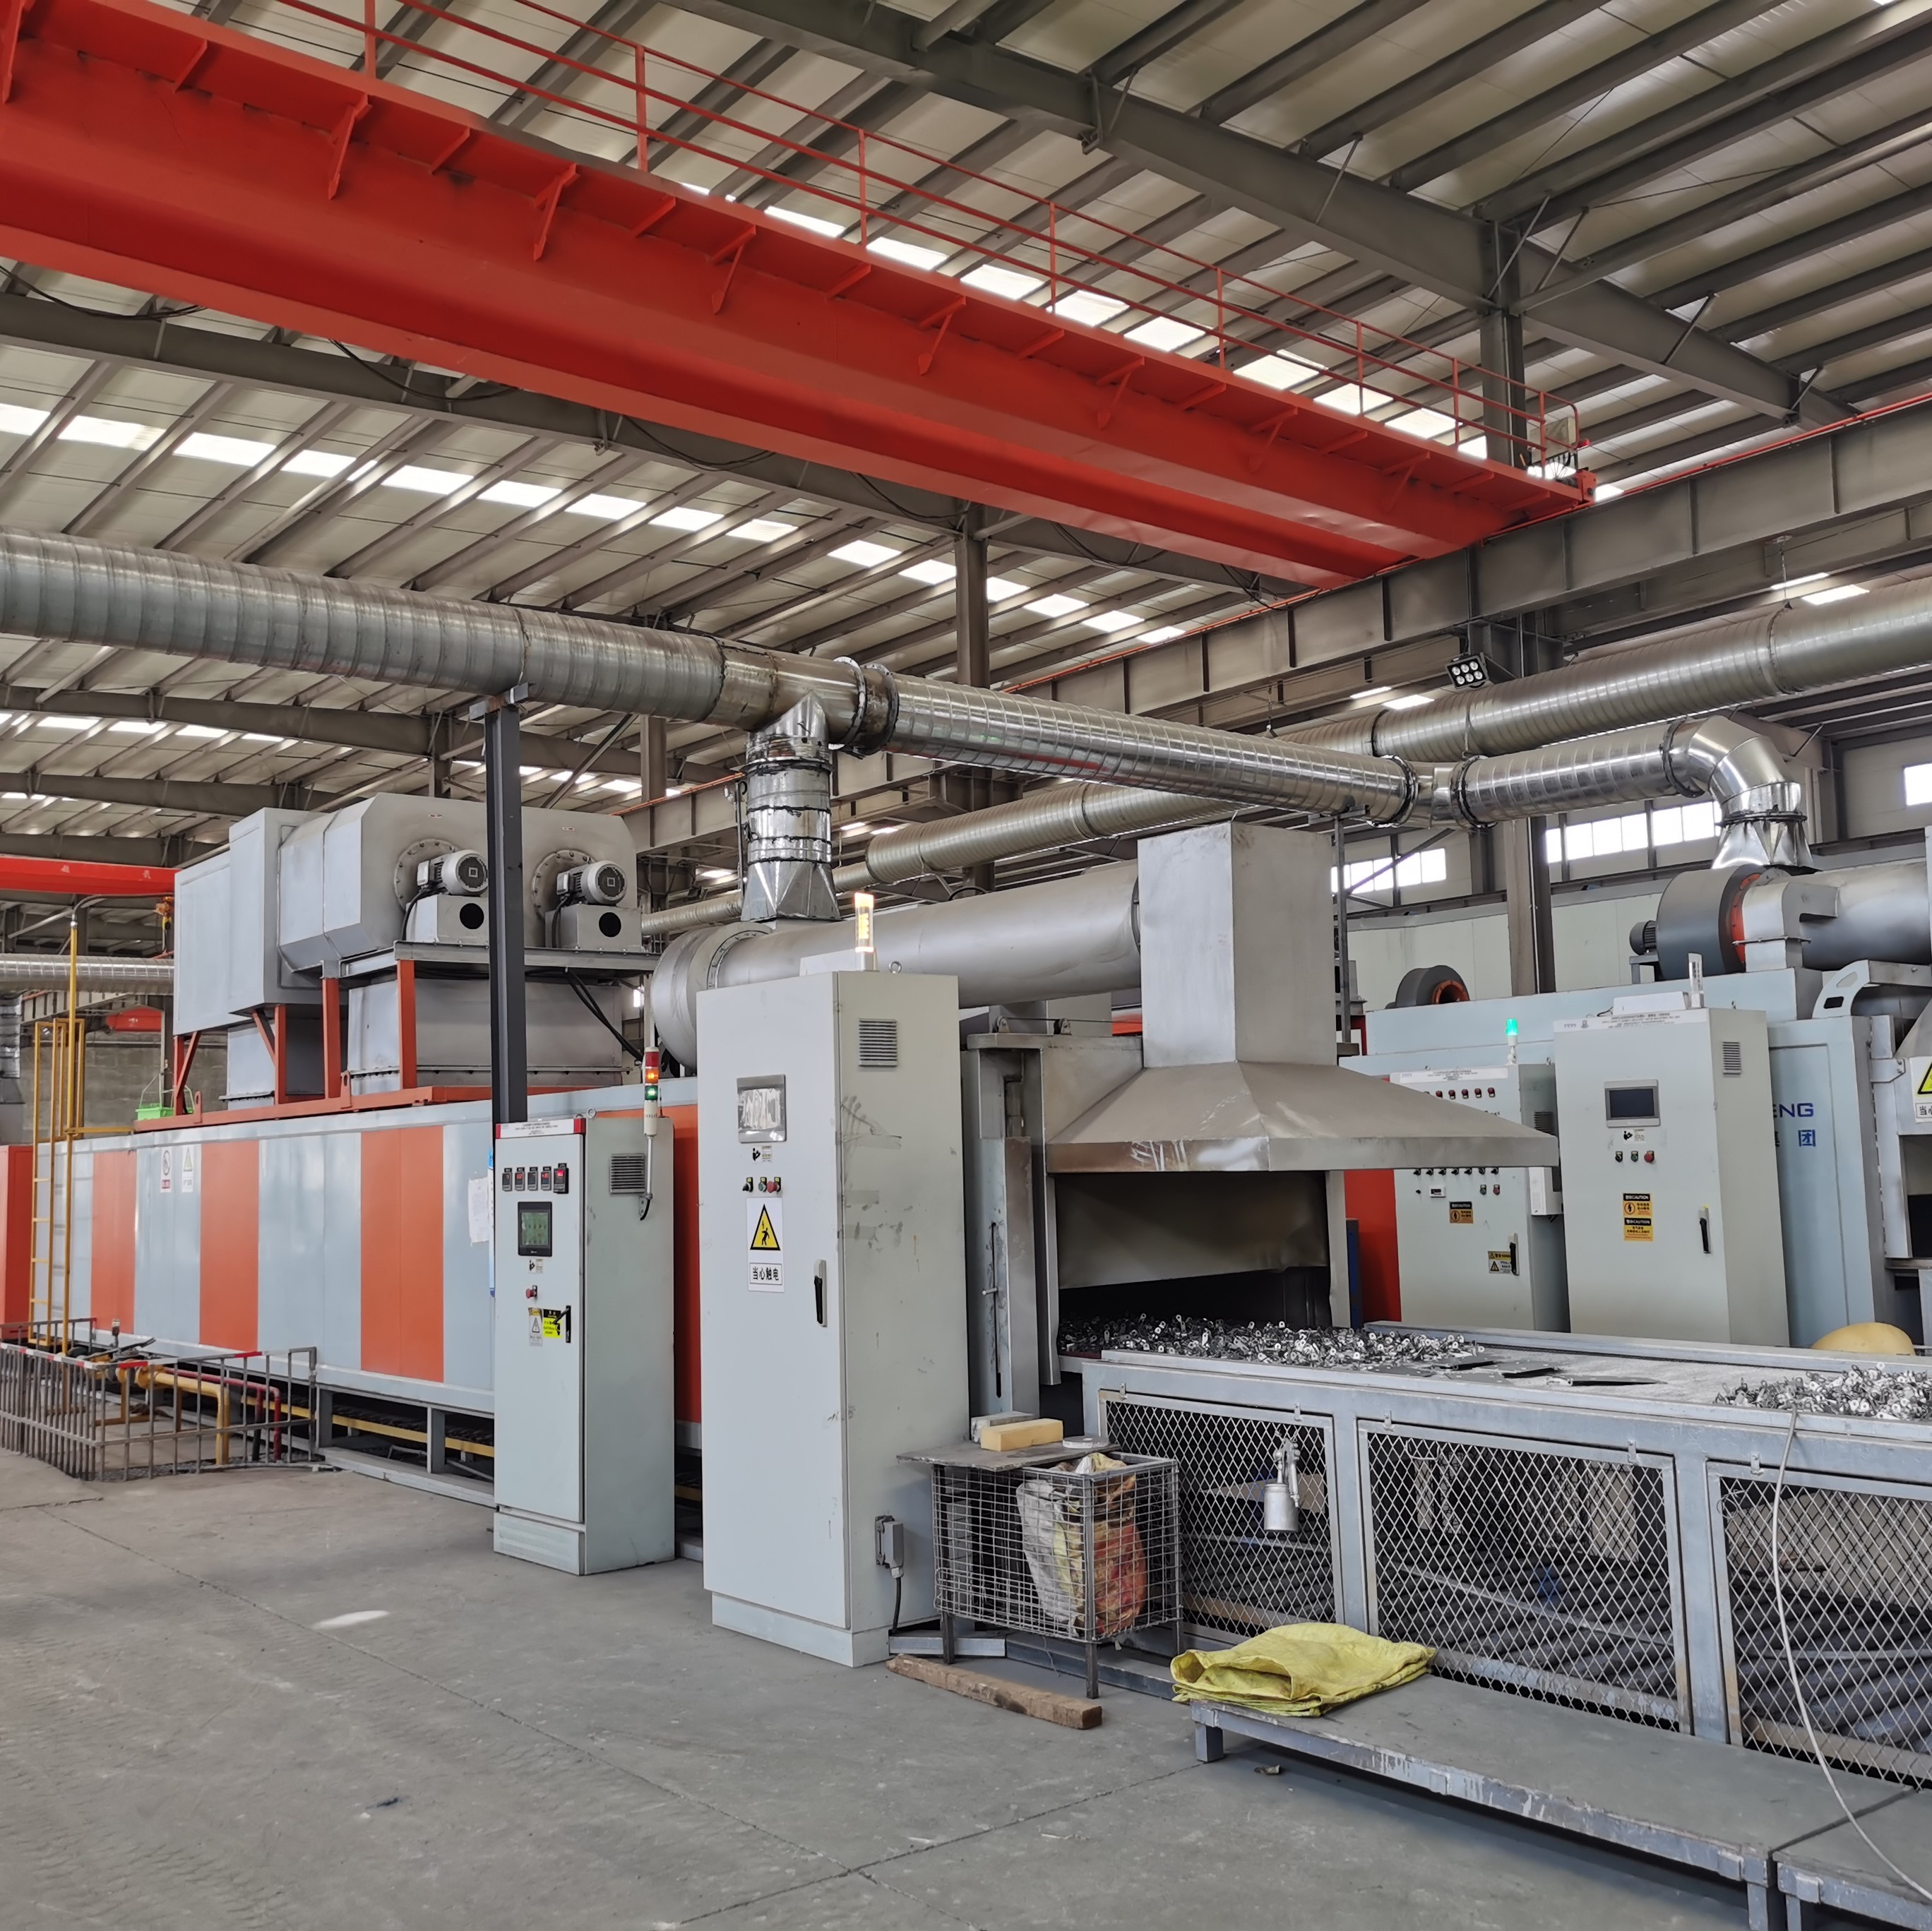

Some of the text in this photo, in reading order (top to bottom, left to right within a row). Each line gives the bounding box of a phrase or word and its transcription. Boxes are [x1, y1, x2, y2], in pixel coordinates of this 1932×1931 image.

[1773, 1103, 1814, 1118] NG
[753, 1267, 779, 1281] 当心触电
